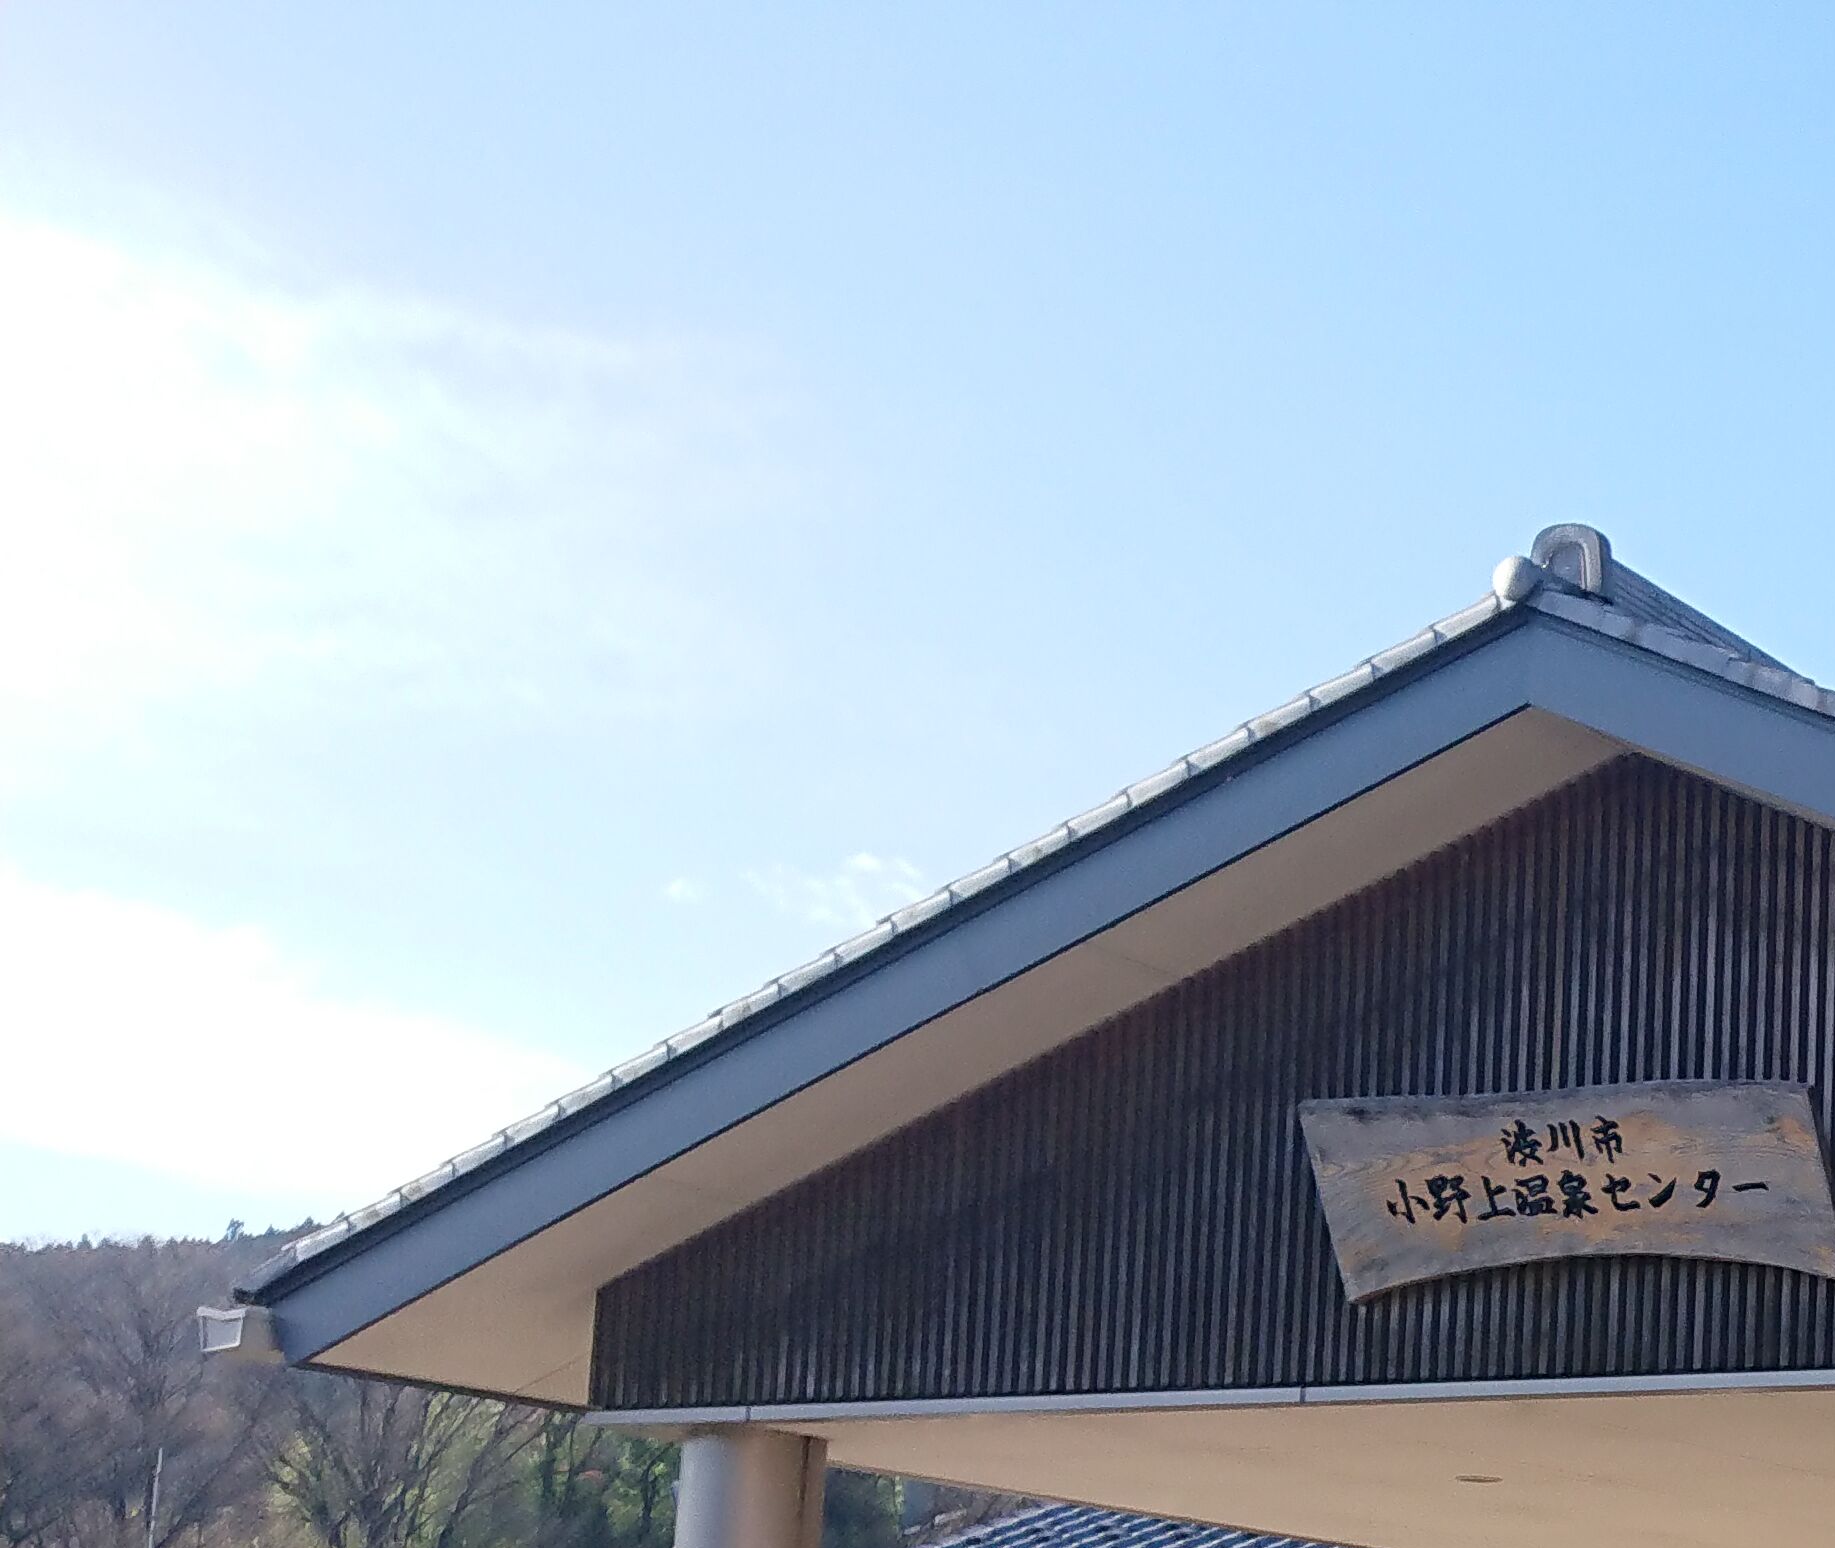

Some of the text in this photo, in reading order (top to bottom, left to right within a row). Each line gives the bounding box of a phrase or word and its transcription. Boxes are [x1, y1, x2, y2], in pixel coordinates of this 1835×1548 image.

[1501, 1114, 1624, 1167] 渋川市
[1386, 1168, 1770, 1224] 小野上温泉センター
